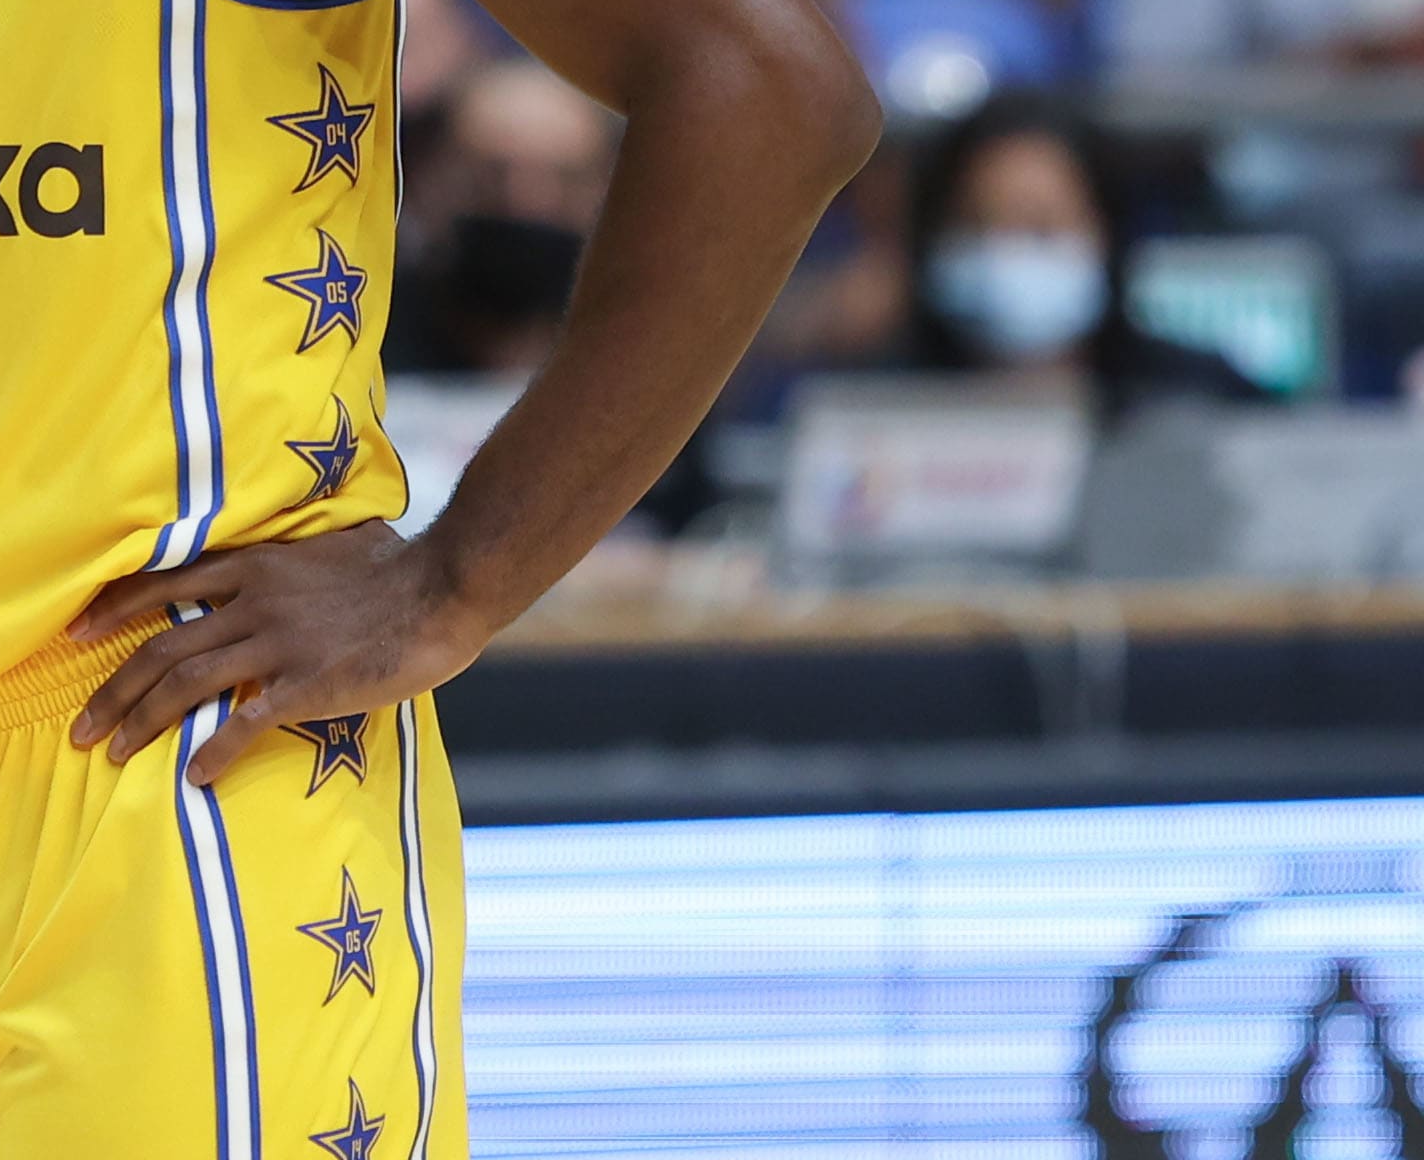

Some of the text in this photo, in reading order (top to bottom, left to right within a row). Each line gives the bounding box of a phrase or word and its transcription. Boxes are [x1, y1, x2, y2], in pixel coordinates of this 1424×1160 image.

[326, 121, 347, 145] 04
[326, 280, 348, 305] 05
[329, 455, 345, 477] 14
[327, 720, 350, 746] 04
[344, 928, 362, 955] 05
